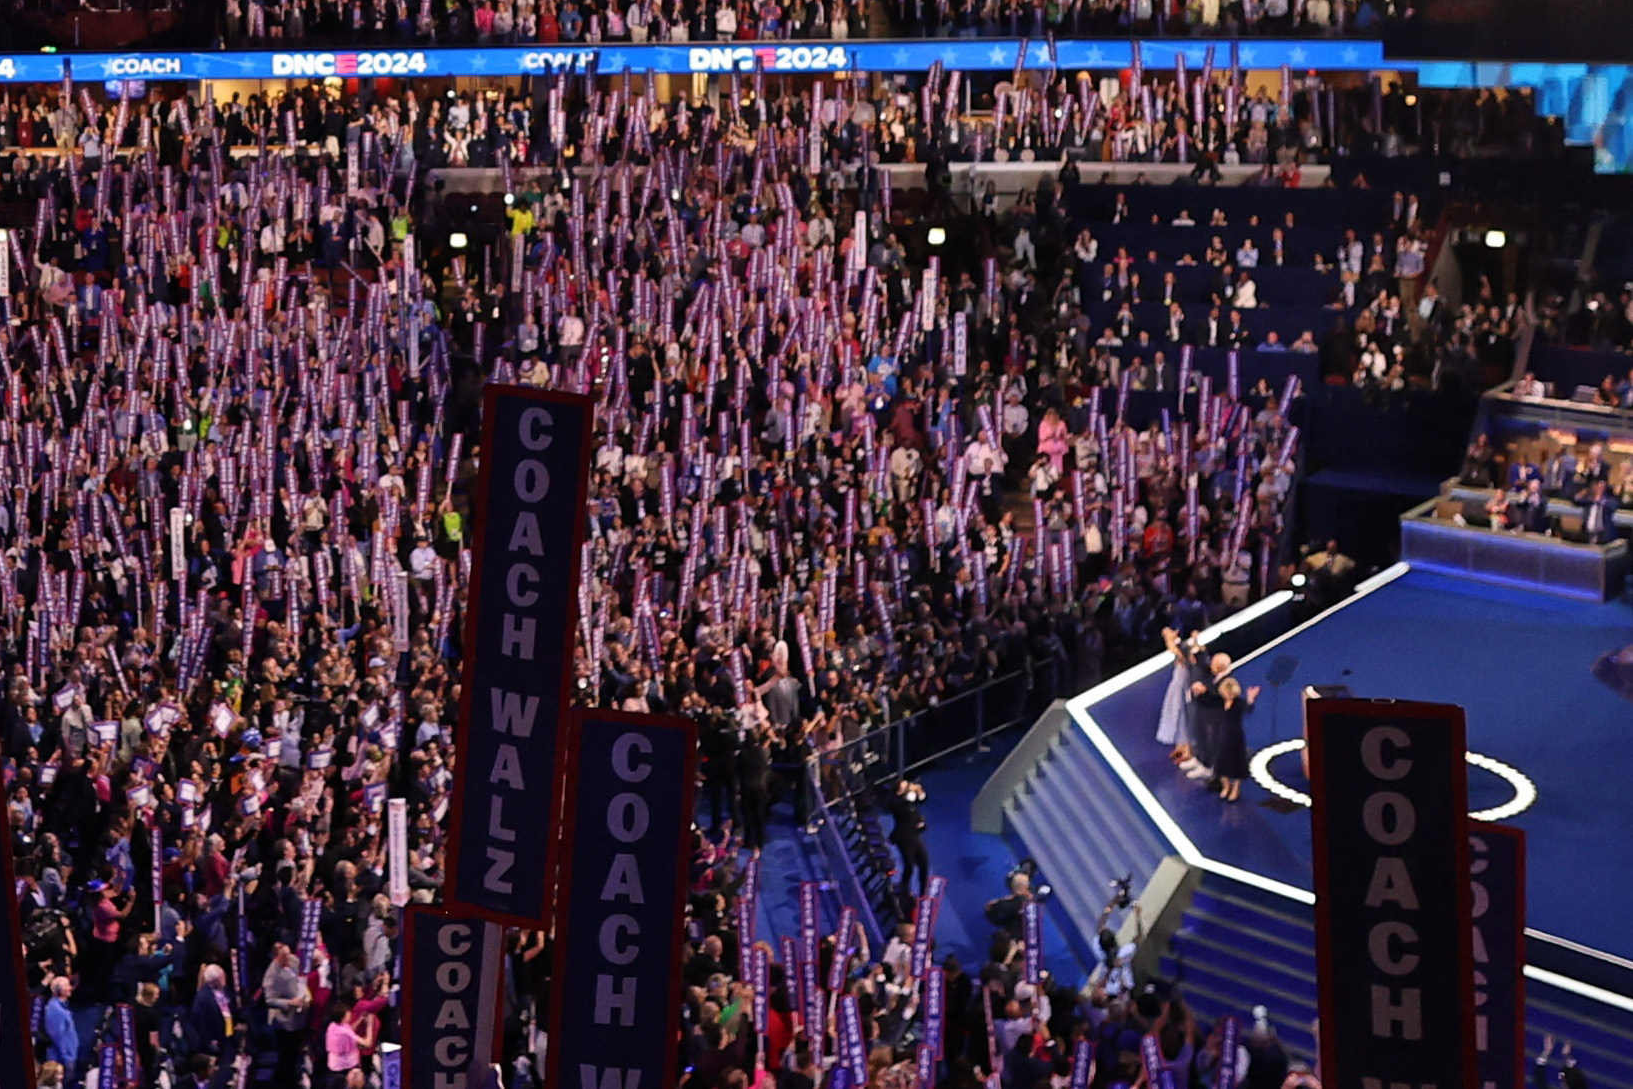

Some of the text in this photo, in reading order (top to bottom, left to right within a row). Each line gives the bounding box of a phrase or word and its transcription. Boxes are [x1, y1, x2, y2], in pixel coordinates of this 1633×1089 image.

[110, 57, 181, 76] COACH
[273, 52, 427, 76] DNC 2024
[777, 47, 847, 70] 2024
[483, 407, 554, 895] COACH WALZ
[594, 732, 654, 1028] COACH
[1360, 725, 1423, 1042] COACH
